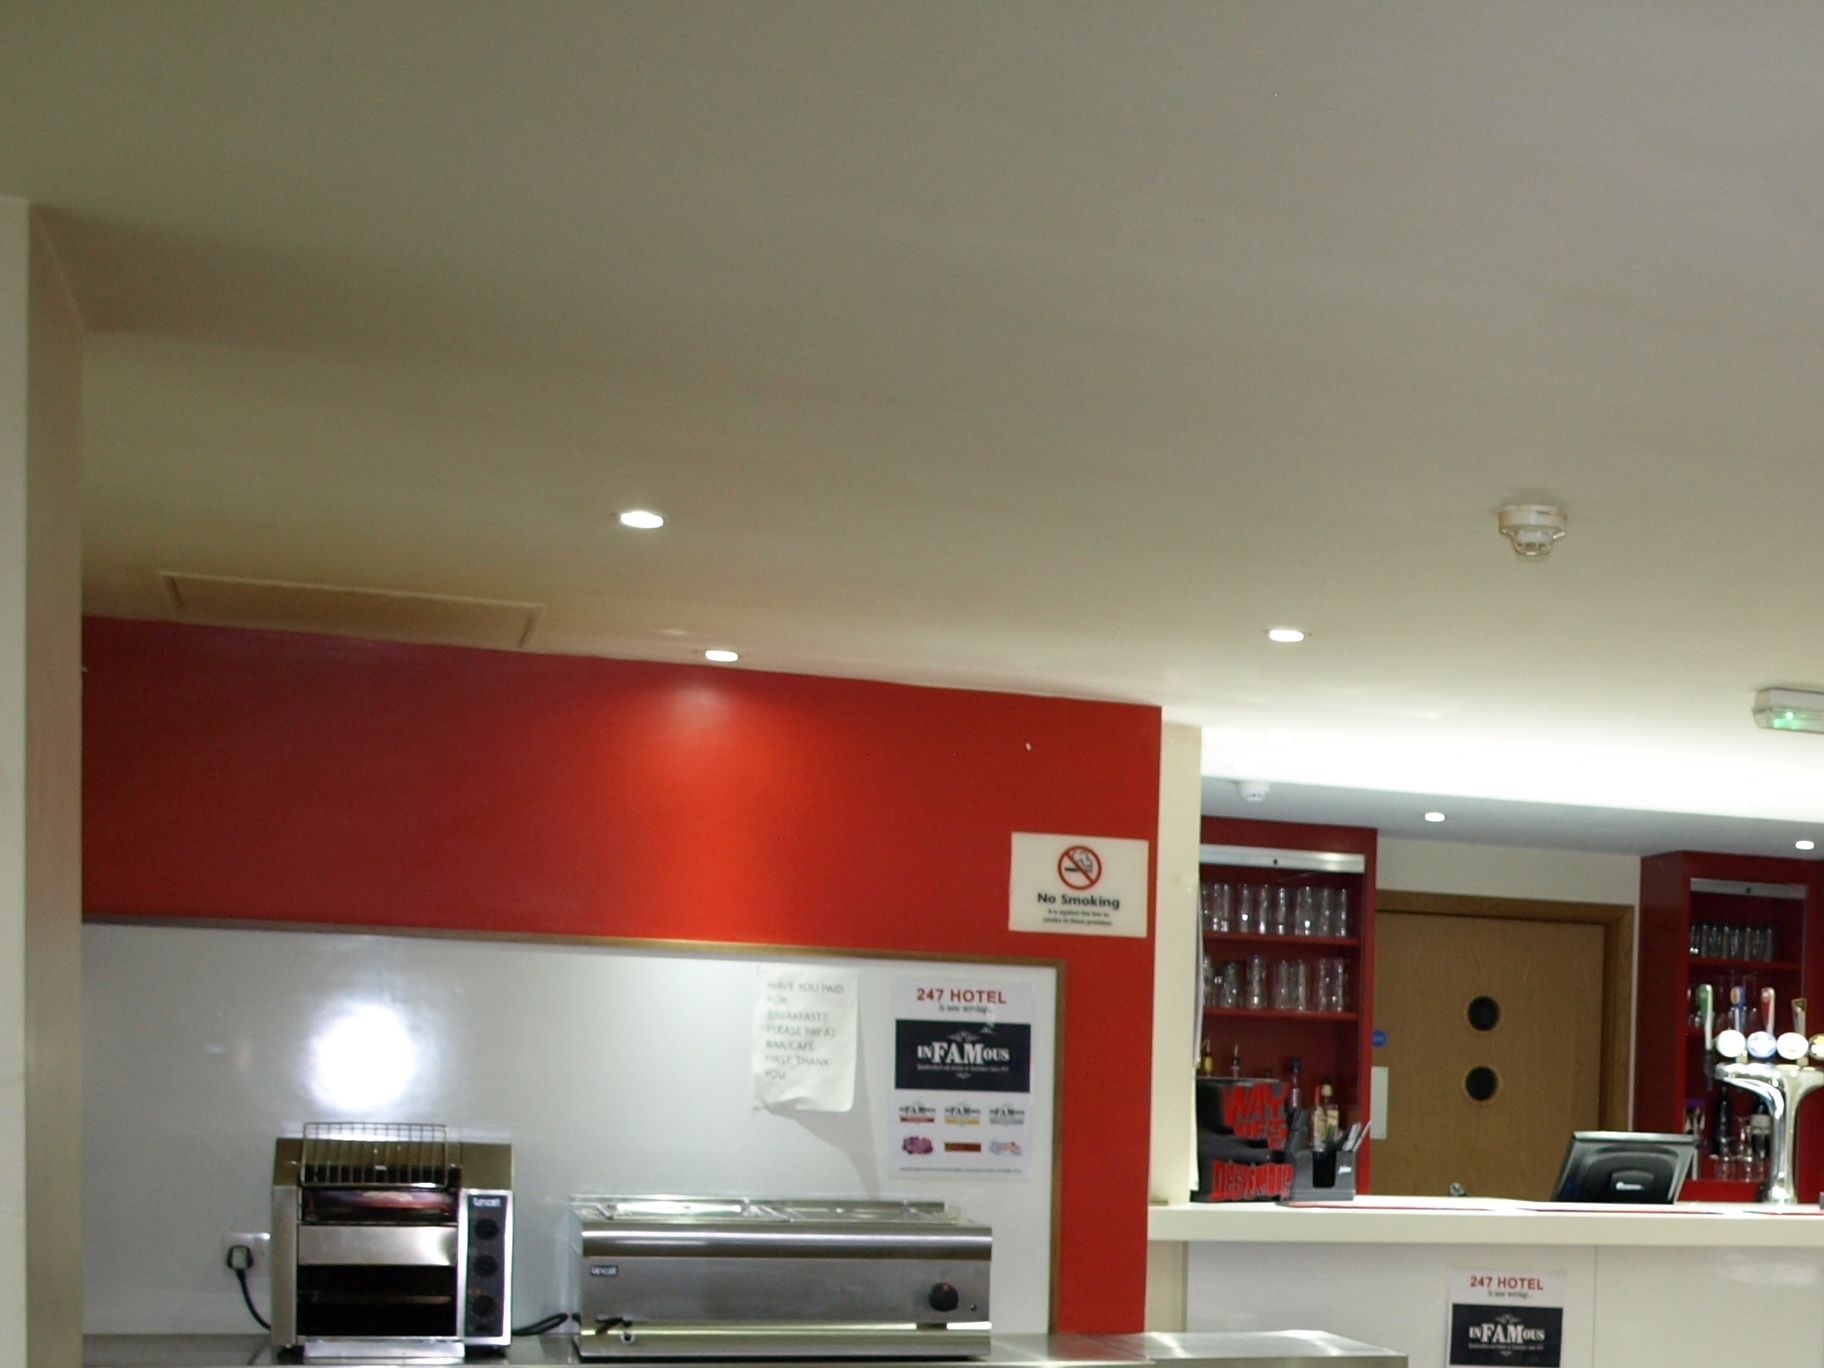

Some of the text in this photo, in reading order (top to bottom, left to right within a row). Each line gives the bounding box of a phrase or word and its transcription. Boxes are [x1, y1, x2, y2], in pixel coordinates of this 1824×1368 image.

[1037, 893, 1120, 910] No Smoking
[798, 983, 819, 993] YOU
[821, 984, 845, 995] PAID
[917, 988, 1007, 1004] 247 HOTEL
[1470, 1276, 1544, 1290] 247 HOTEL
